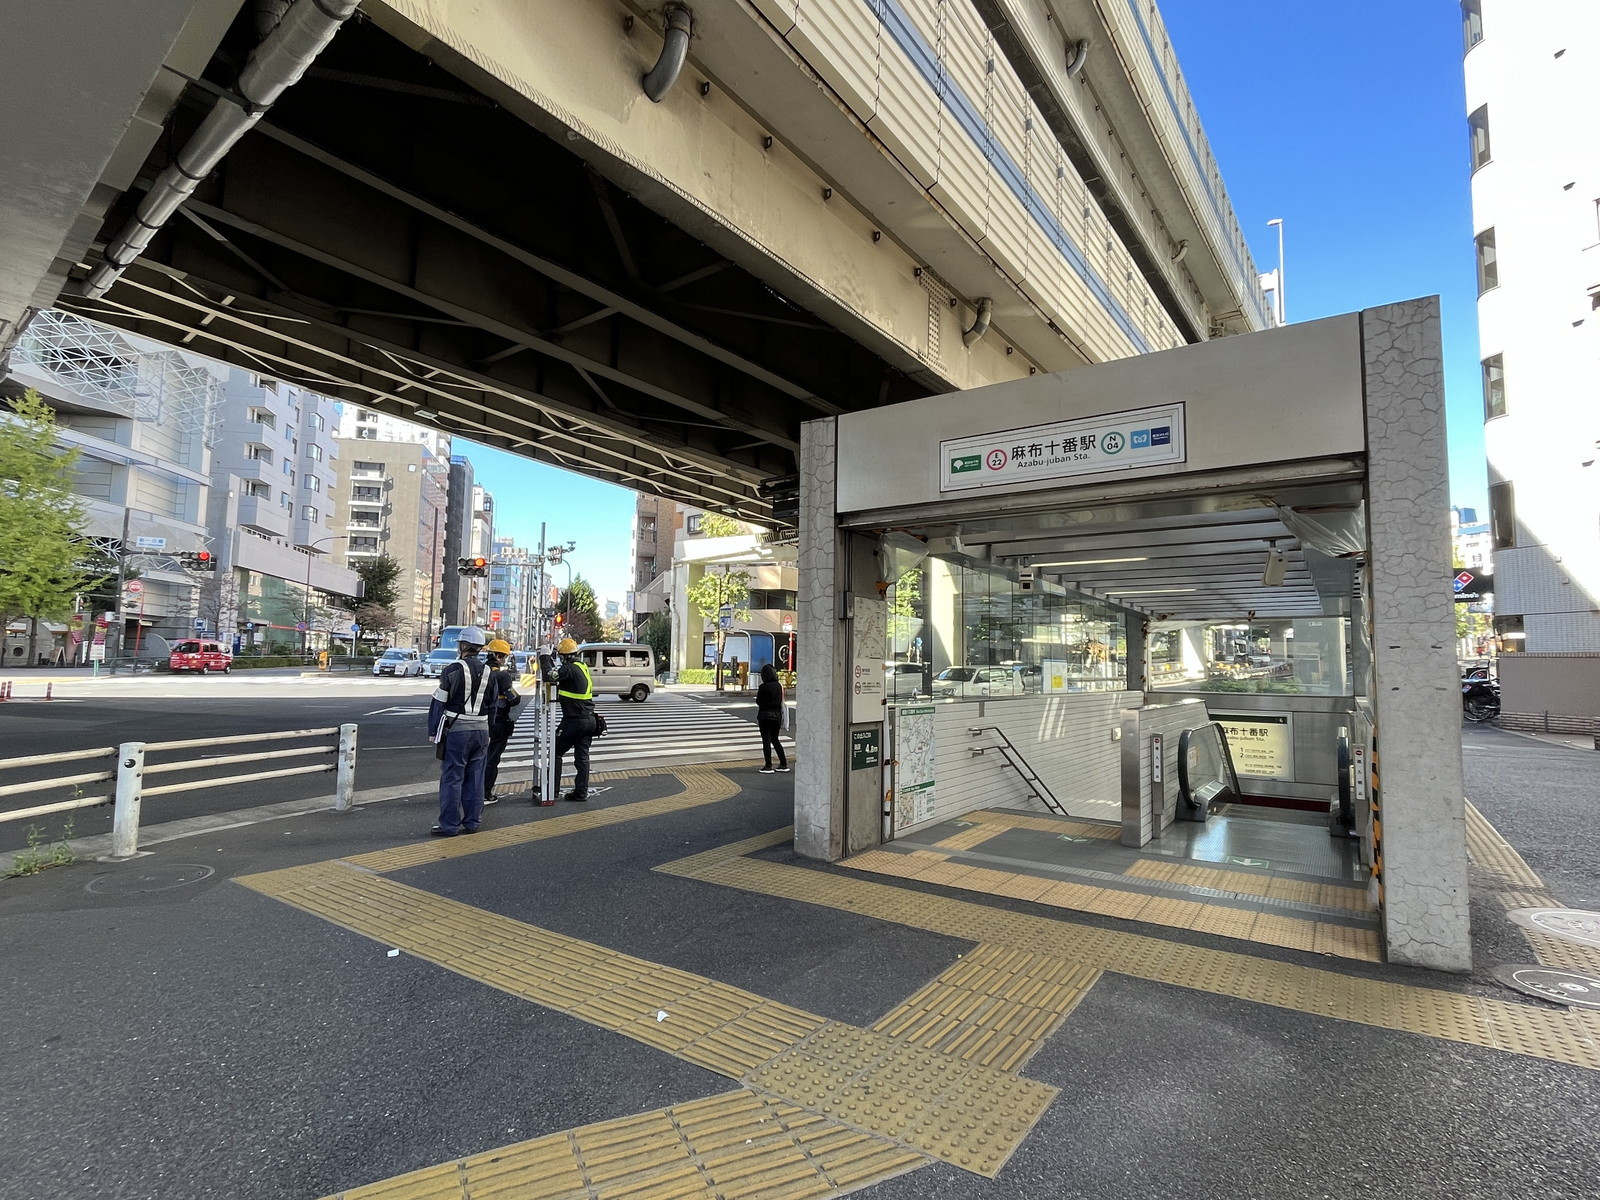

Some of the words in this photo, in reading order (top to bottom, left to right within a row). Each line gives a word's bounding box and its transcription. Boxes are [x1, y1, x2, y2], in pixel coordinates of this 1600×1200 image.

[1109, 435, 1117, 443] N
[1011, 434, 1097, 461] 麻布十番駅
[1106, 442, 1119, 450] 04
[991, 459, 1002, 467] 22
[1017, 454, 1071, 469] Azabu-juban
[1073, 452, 1091, 461] Sta.
